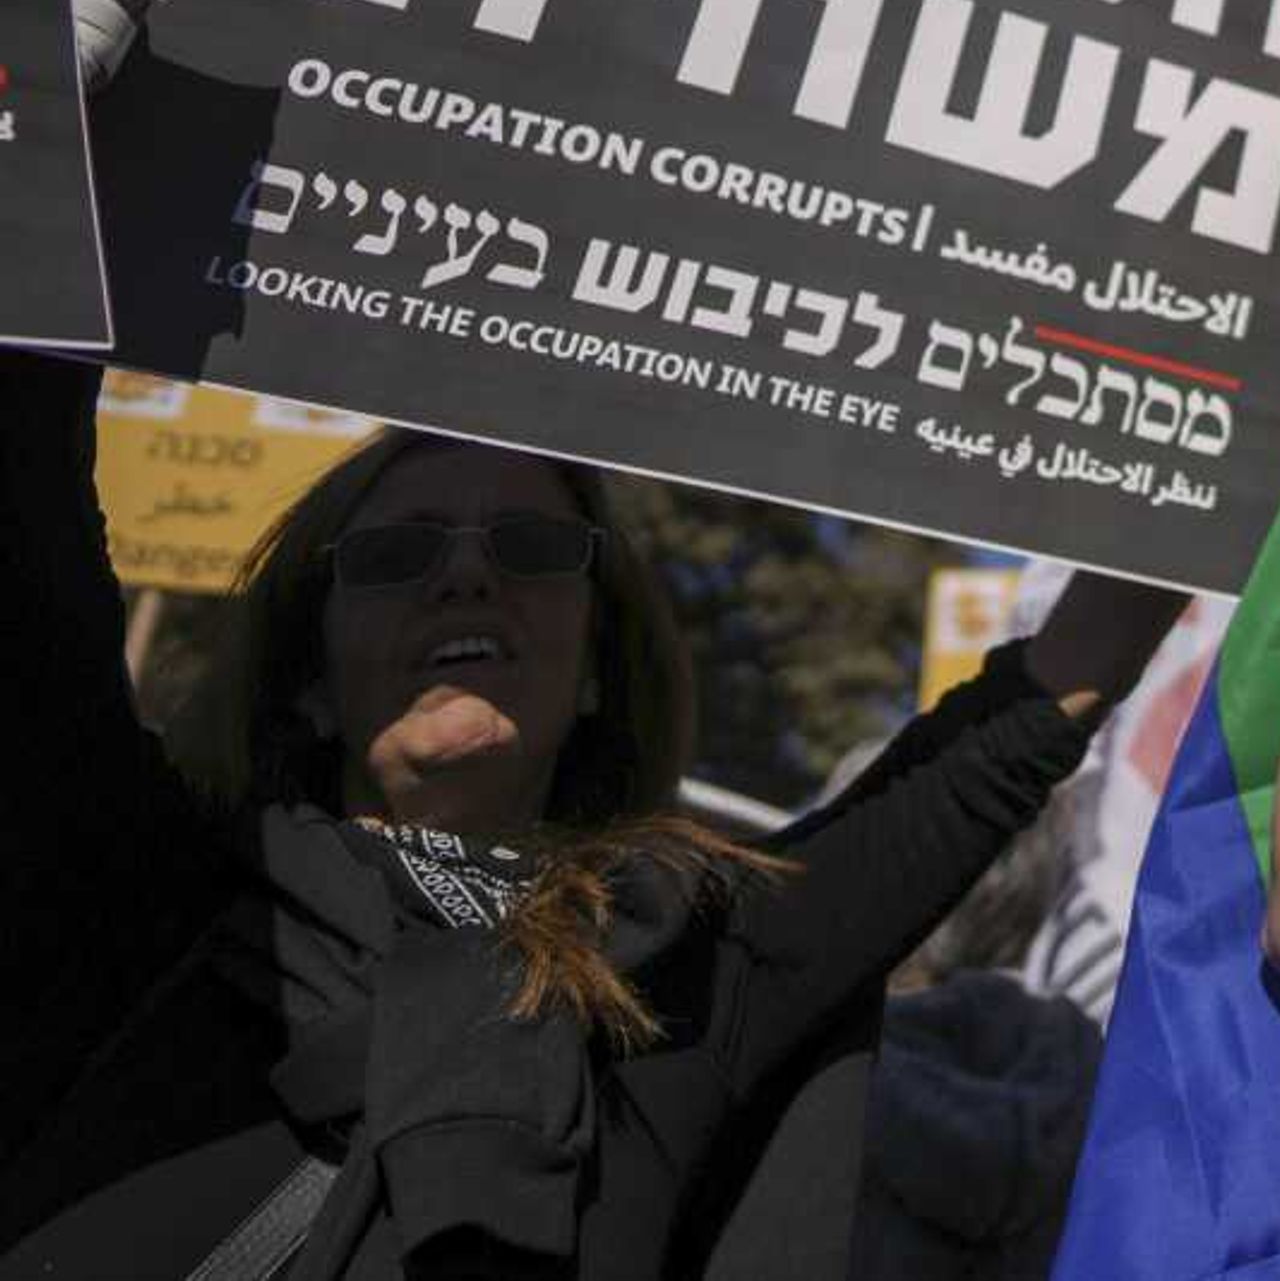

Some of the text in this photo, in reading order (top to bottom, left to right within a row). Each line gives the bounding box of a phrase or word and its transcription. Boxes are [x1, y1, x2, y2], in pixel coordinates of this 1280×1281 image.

[288, 59, 910, 245] OCCUPATION CORRUPTS
[231, 162, 1232, 456] מסתכלים לכיבוש בעיניים
[940, 229, 1253, 339] الاحتلال مفسد
[205, 256, 901, 433] LOOKING THE OCCUPATION IN THE EYE
[915, 417, 995, 459] عينيه
[998, 434, 1033, 478] في
[1036, 442, 1155, 495] الاحتلال
